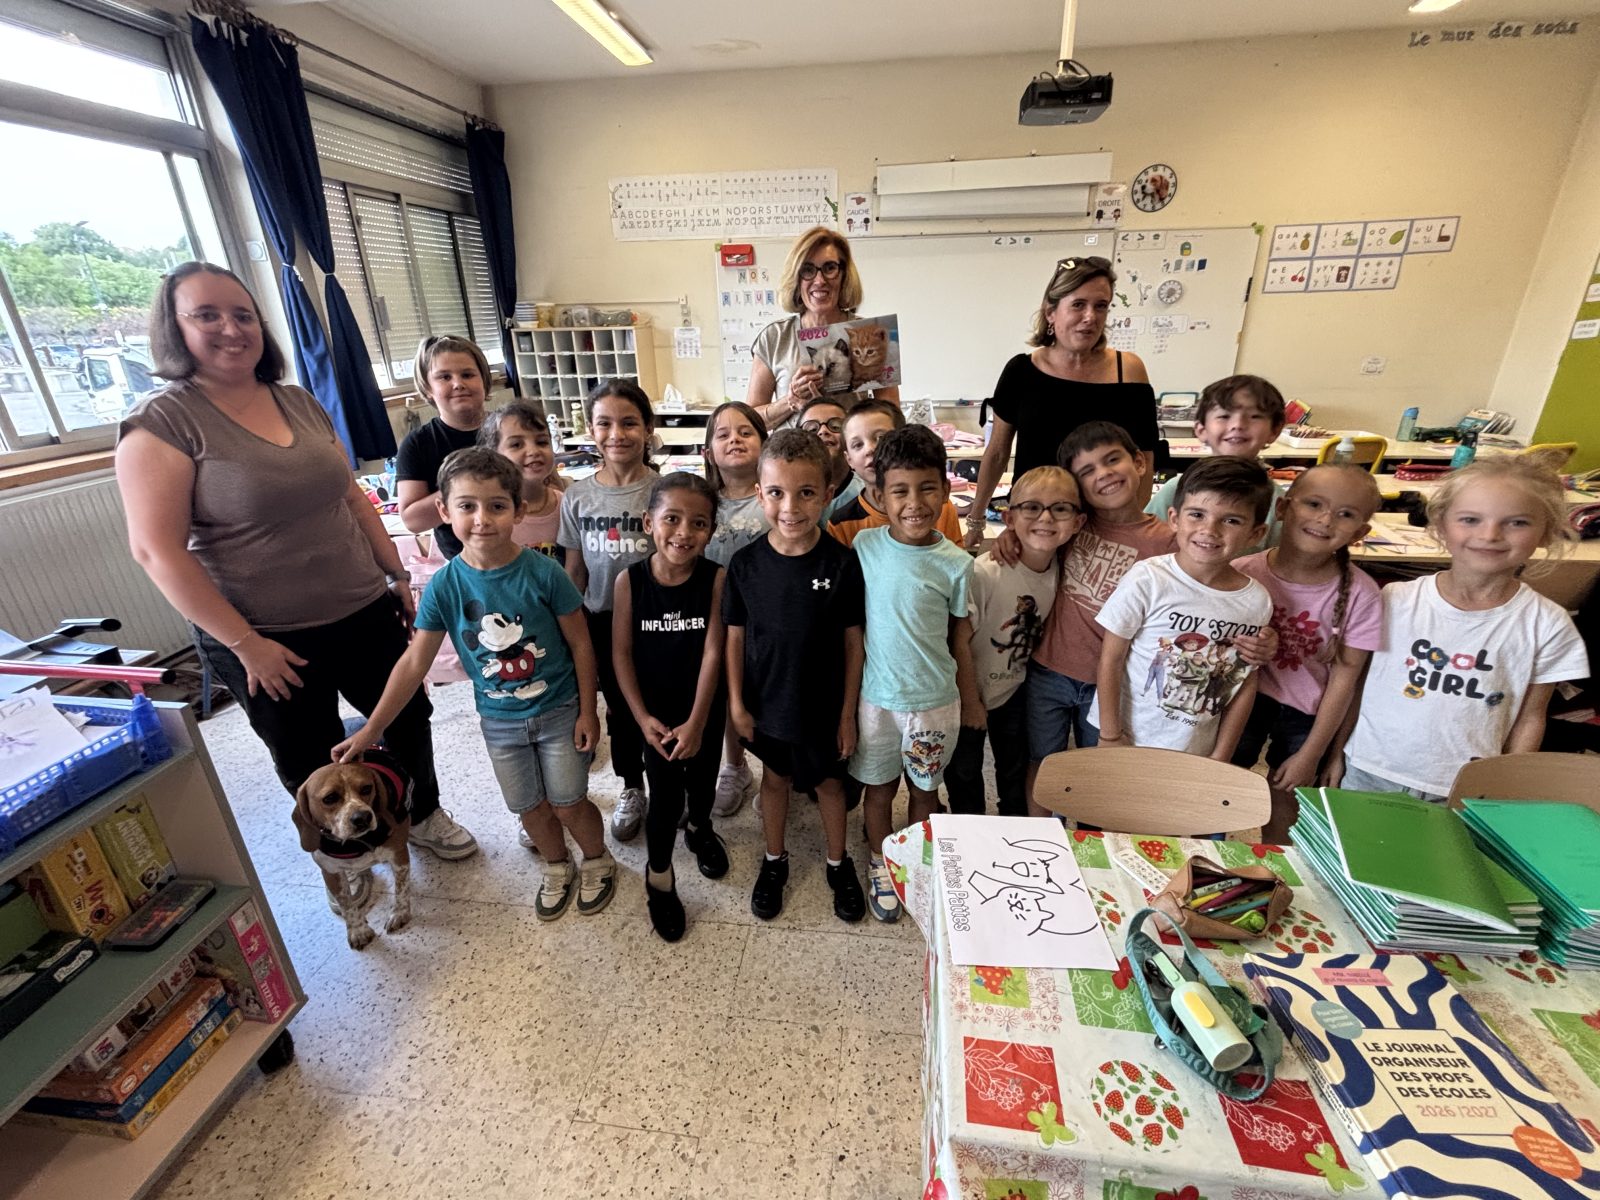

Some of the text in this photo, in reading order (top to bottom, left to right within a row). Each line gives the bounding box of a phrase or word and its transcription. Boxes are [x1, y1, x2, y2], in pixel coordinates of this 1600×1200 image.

[1408, 20, 1580, 48] Le mur des sons
[1098, 200, 1121, 208] DROITE
[798, 327, 828, 341] 2026
[579, 511, 644, 532] marin
[586, 531, 648, 553] blanc
[663, 610, 681, 620] mini
[641, 617, 706, 632] INFLUENCER
[1168, 612, 1262, 640] TOY STOR
[1408, 666, 1485, 699] GIRL
[1182, 716, 1198, 727] 1995
[938, 838, 970, 932] Les Petites Pattes
[1363, 1042, 1456, 1054] LE JOURNAL
[1370, 1056, 1470, 1069] ORGANISEUR
[1390, 1072, 1474, 1084] DES PROFS
[1396, 1084, 1492, 1099] DES ÉCOLES
